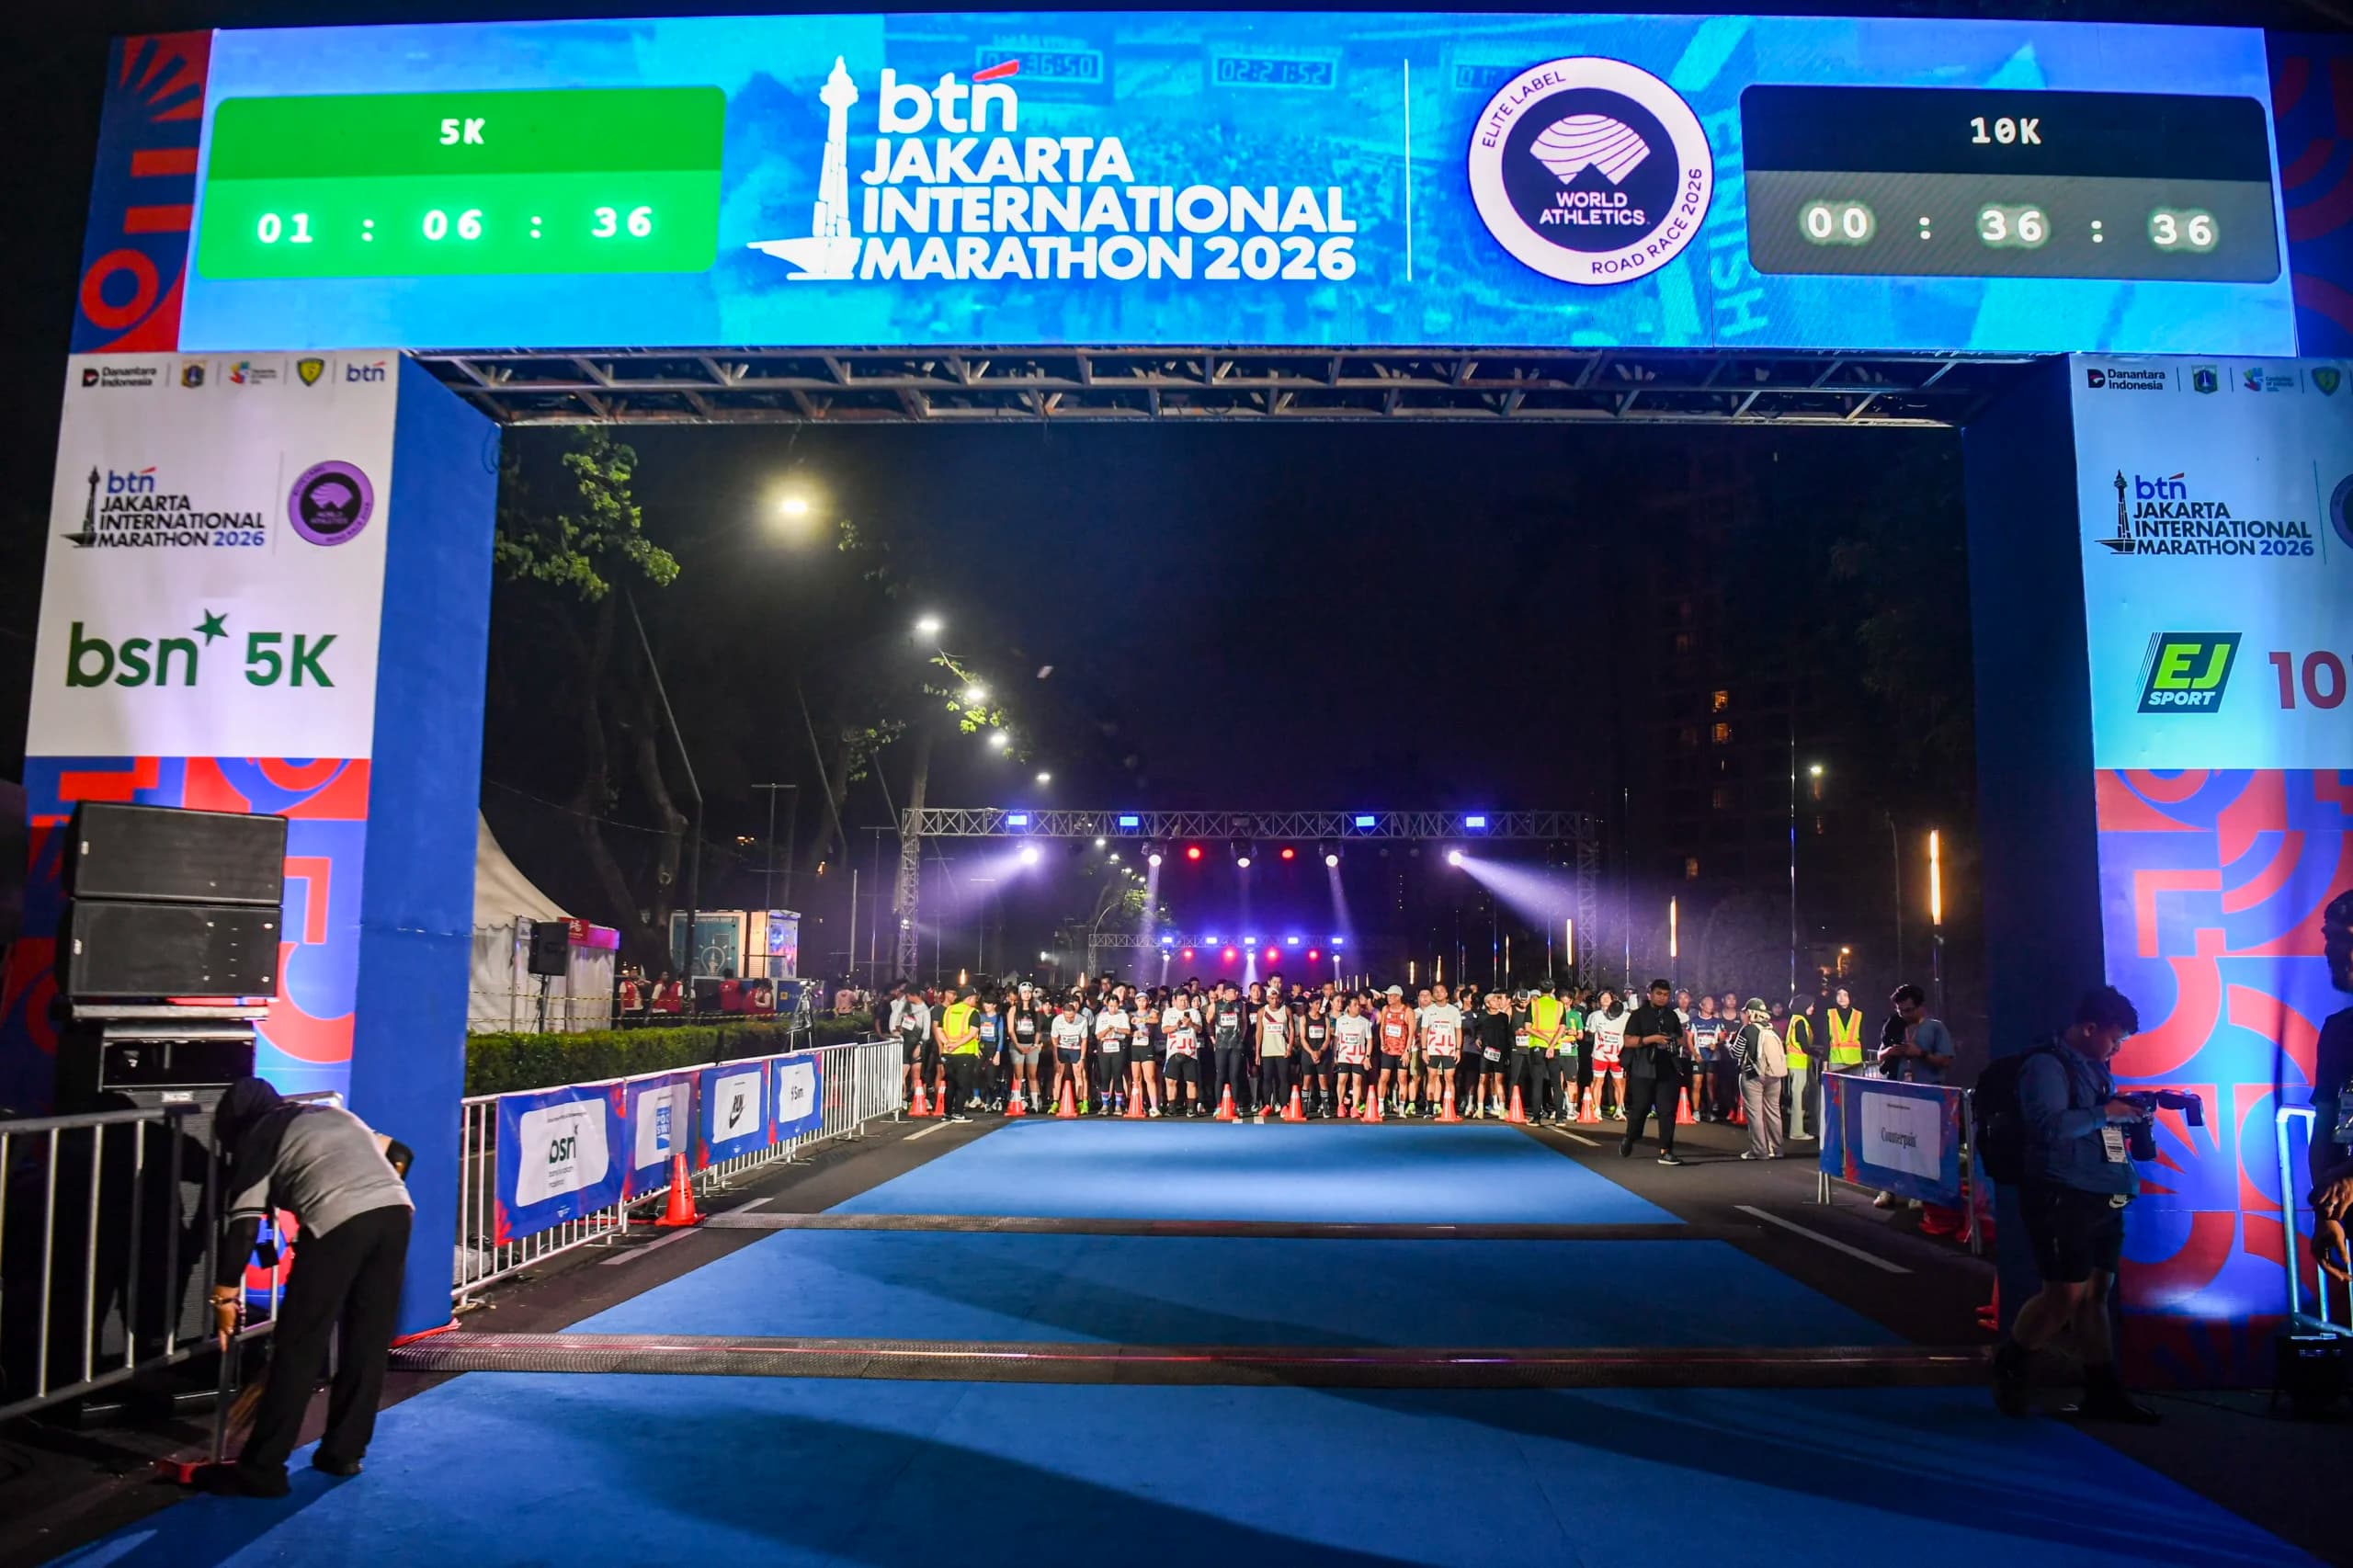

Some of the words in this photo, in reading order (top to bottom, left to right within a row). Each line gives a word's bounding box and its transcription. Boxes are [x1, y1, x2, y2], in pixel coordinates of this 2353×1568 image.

[879, 60, 1019, 134] btn
[1482, 104, 1513, 148] ELITE
[1511, 71, 1567, 105] LABEL
[439, 118, 486, 145] 5K
[1970, 116, 2042, 146] 10K
[860, 136, 1135, 187] JAKARTA
[862, 186, 1357, 234] INTERNATIONAL
[1555, 191, 1628, 207] WORLD
[256, 212, 313, 244] 01
[422, 209, 483, 241] 06
[591, 206, 654, 237] 36
[1539, 209, 1646, 225] ATHLETICS
[1591, 253, 1645, 275] ROAD
[1646, 221, 1688, 257] RACE
[1681, 167, 1702, 216] 2026
[1806, 206, 1869, 240] 00
[1981, 208, 2043, 242] 36
[2153, 214, 2213, 247] 36
[859, 236, 1194, 281] MARATHON
[1203, 235, 1357, 281] 2026
[101, 378, 153, 387] Indonesia
[102, 366, 157, 377] Danantara
[346, 361, 387, 383] btn
[2108, 369, 2165, 380] Danantara
[2109, 381, 2164, 391] Indonesia
[107, 466, 157, 494] btn
[2134, 472, 2188, 500] btn
[100, 494, 191, 513] JAKARTA
[2133, 502, 2232, 519] JAKARTA
[99, 512, 266, 530] INTERNATIONAL
[2134, 520, 2313, 540] INTERNATIONAL
[96, 531, 209, 549] MARATHON
[212, 530, 266, 547] 2026
[2136, 540, 2256, 556] MARATHON
[2259, 540, 2314, 557] 2026
[65, 620, 199, 688] bsn
[244, 631, 338, 688] 5K
[2153, 643, 2232, 689] EJ
[2268, 650, 2353, 710] 10
[2147, 691, 2217, 706] SPORT
